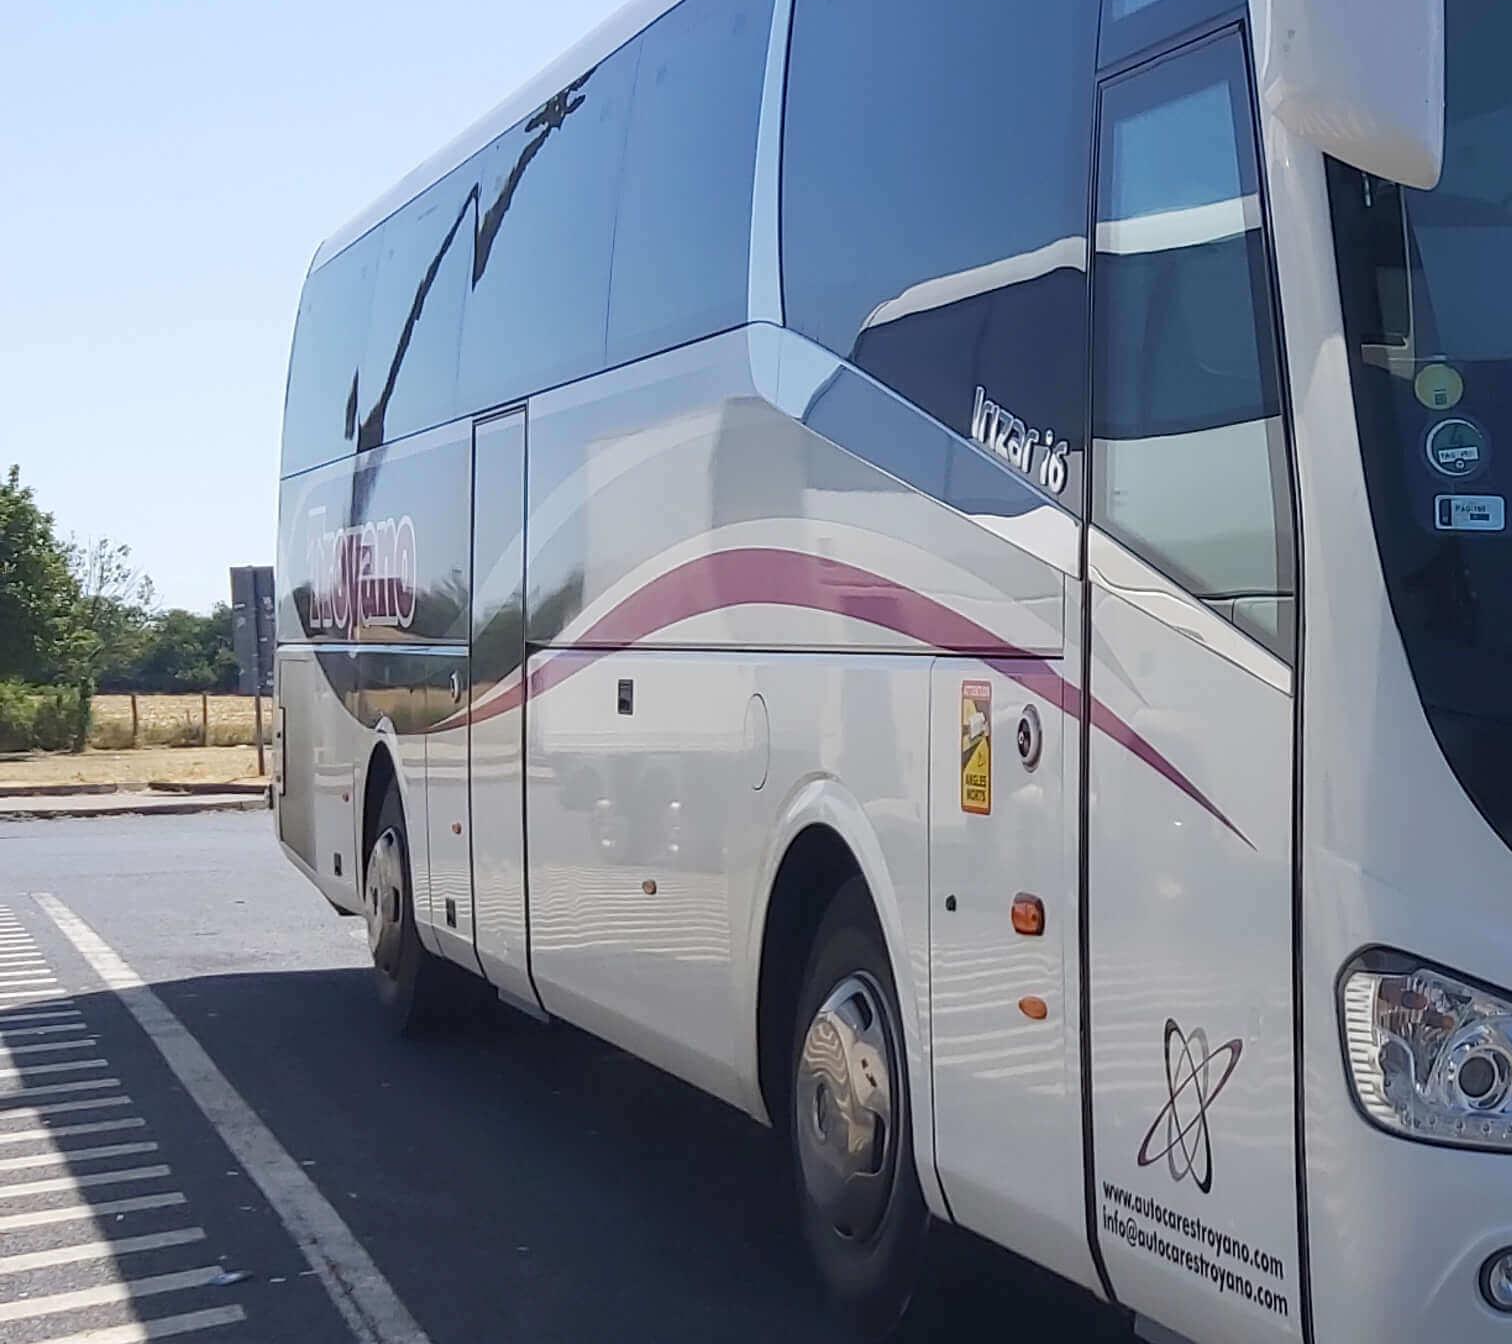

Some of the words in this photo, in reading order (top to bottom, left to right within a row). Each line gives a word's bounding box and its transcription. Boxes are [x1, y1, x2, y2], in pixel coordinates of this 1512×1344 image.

[971, 385, 1041, 474] Irizar
[1039, 428, 1069, 495] i6
[1102, 1180, 1285, 1281] www.autocarestroyano.com
[1102, 1205, 1289, 1317] info@autocarestroyano.com
